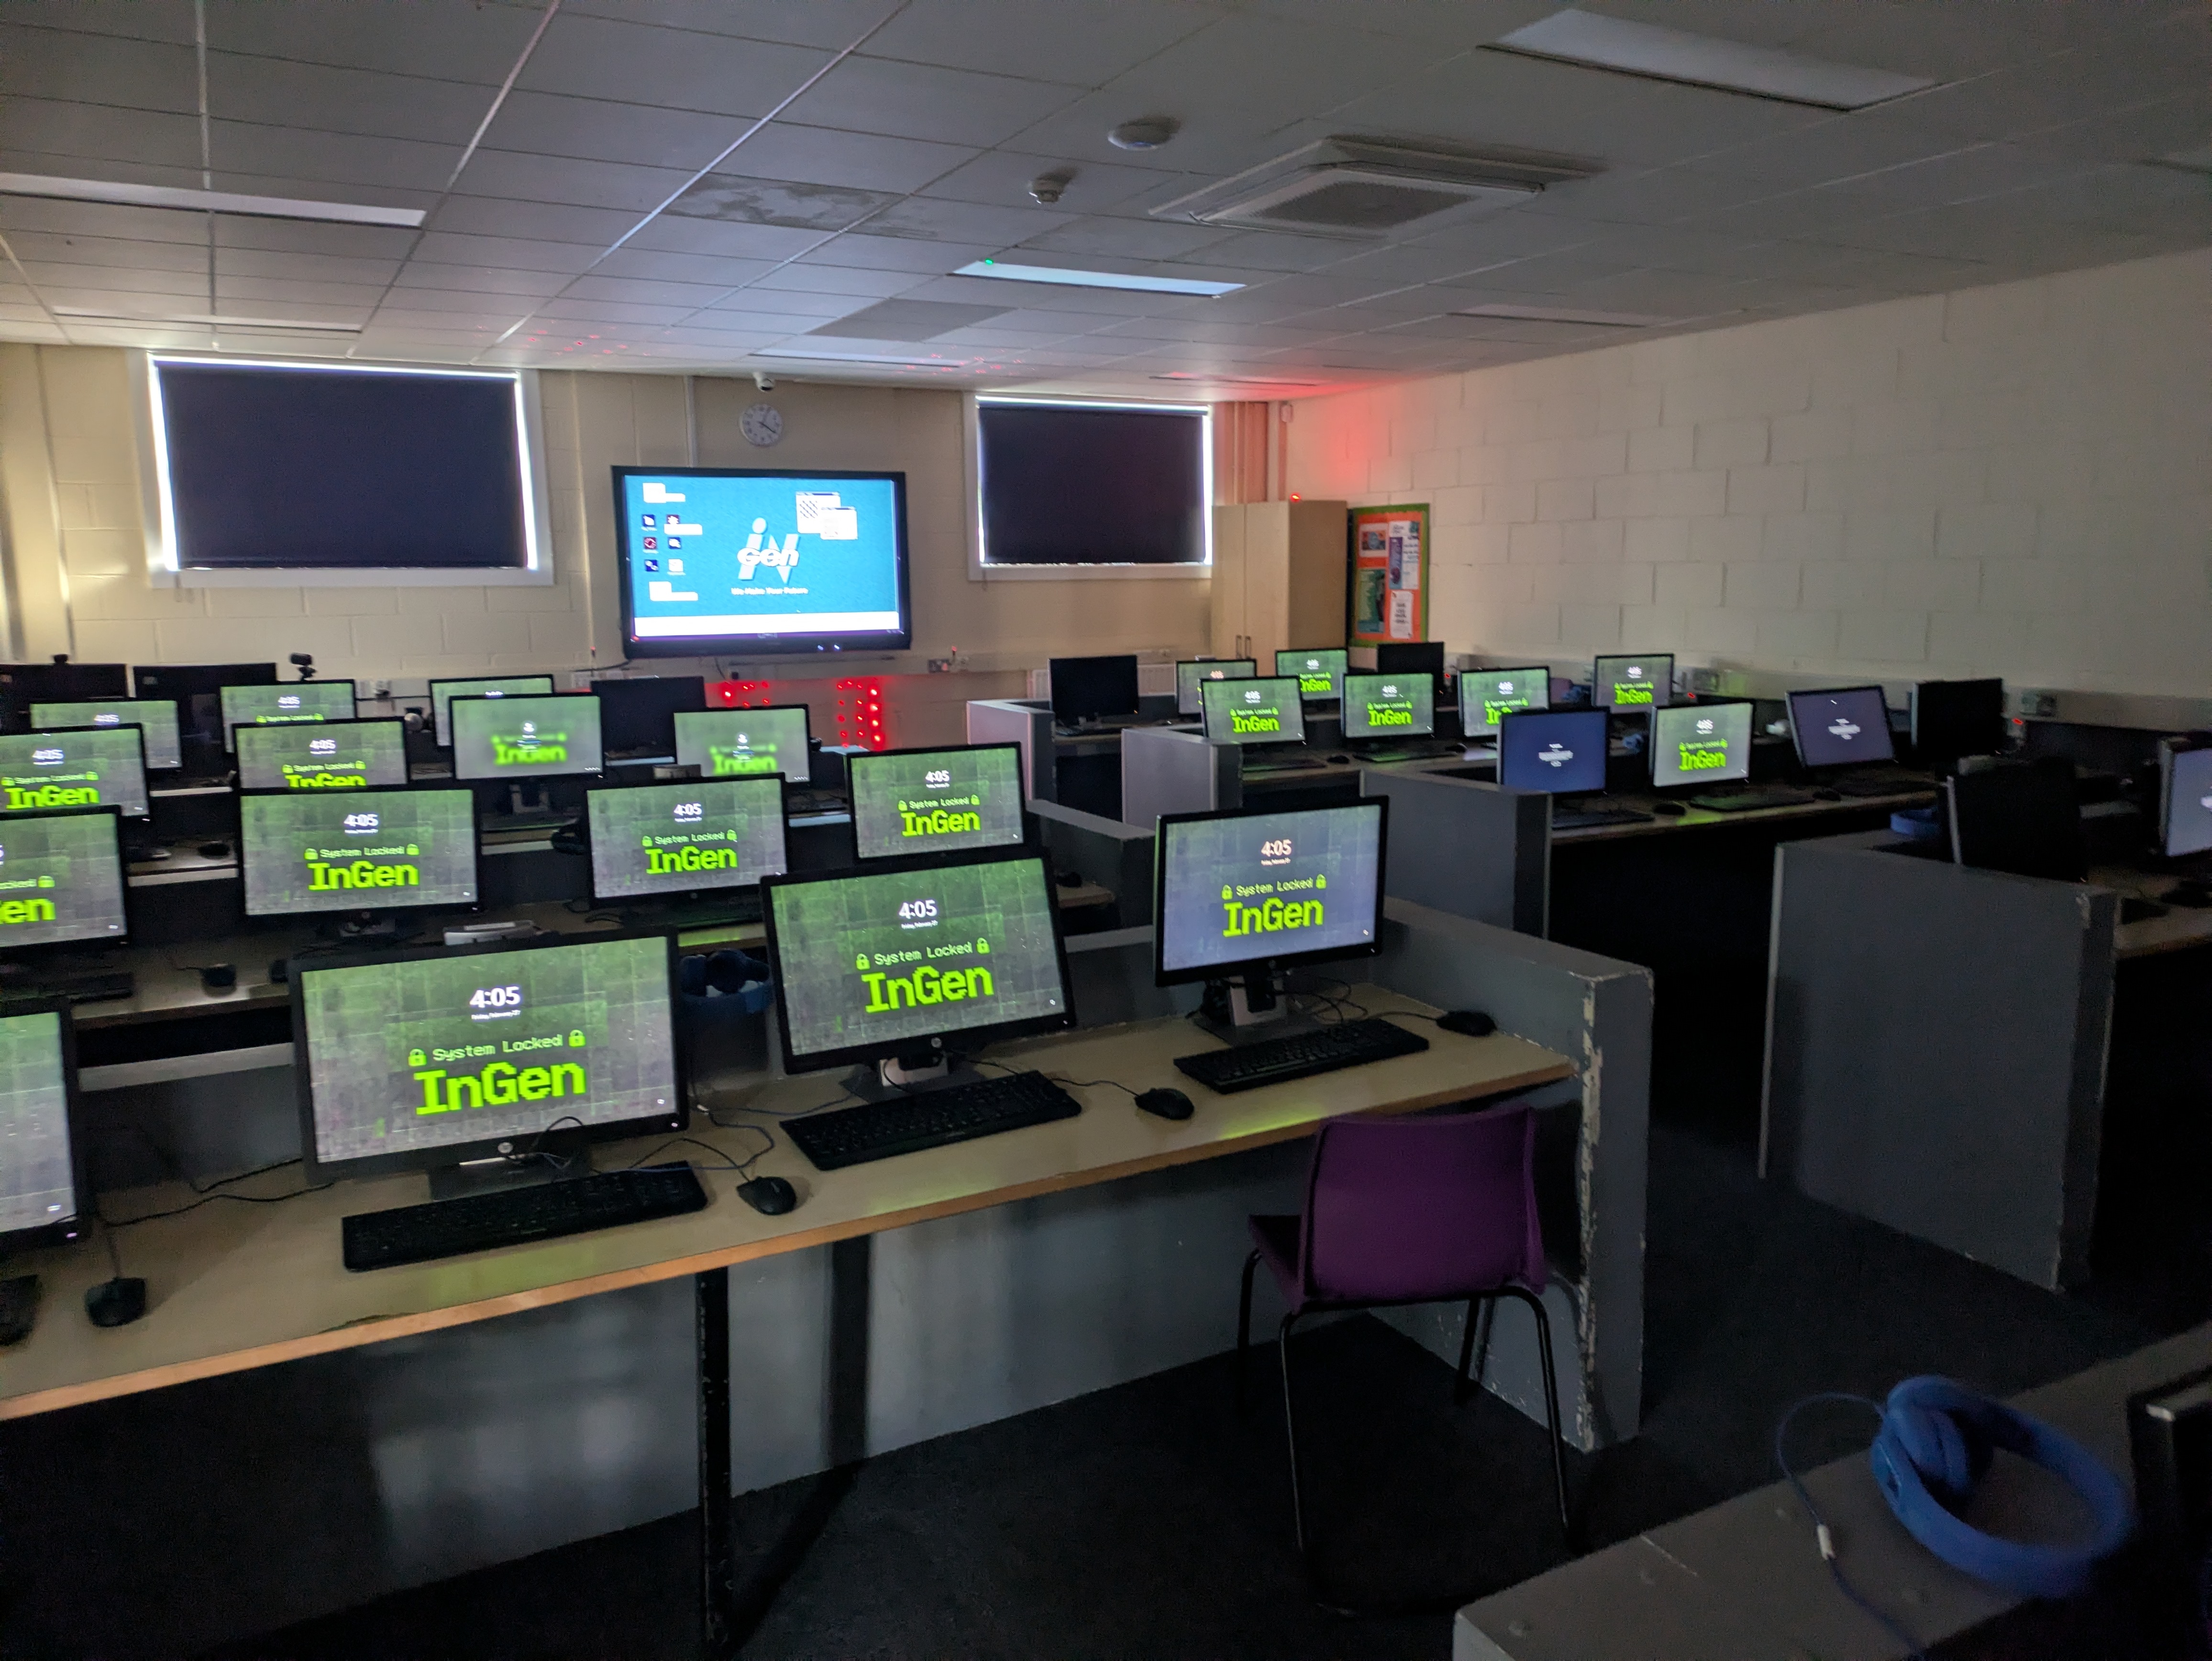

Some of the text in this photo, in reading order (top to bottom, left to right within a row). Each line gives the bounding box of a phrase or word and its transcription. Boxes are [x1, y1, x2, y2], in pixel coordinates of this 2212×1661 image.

[1615, 689, 1653, 705] InGen
[1232, 716, 1280, 733] InGen
[1368, 709, 1412, 726] InGen
[1679, 750, 1726, 771] InGen
[925, 770, 950, 782] 4:05
[5, 786, 100, 809] InGen
[909, 797, 970, 809] System Locked
[674, 803, 702, 816] 4:05
[344, 814, 378, 826] 4:05
[901, 809, 981, 837] InGen
[655, 831, 725, 845] System Locked
[1261, 839, 1292, 857] 4:05
[320, 846, 405, 858] System Locked
[645, 846, 738, 874] InGen
[307, 861, 419, 890] InGen
[1236, 877, 1314, 897] System Locked
[899, 899, 937, 919] 4:05
[1223, 897, 1324, 937] InGen
[874, 941, 973, 965] System Locked
[469, 986, 520, 1008] 4:05
[861, 965, 994, 1013] InGen
[432, 1034, 563, 1062] System Locked
[414, 1062, 586, 1115] InGen
